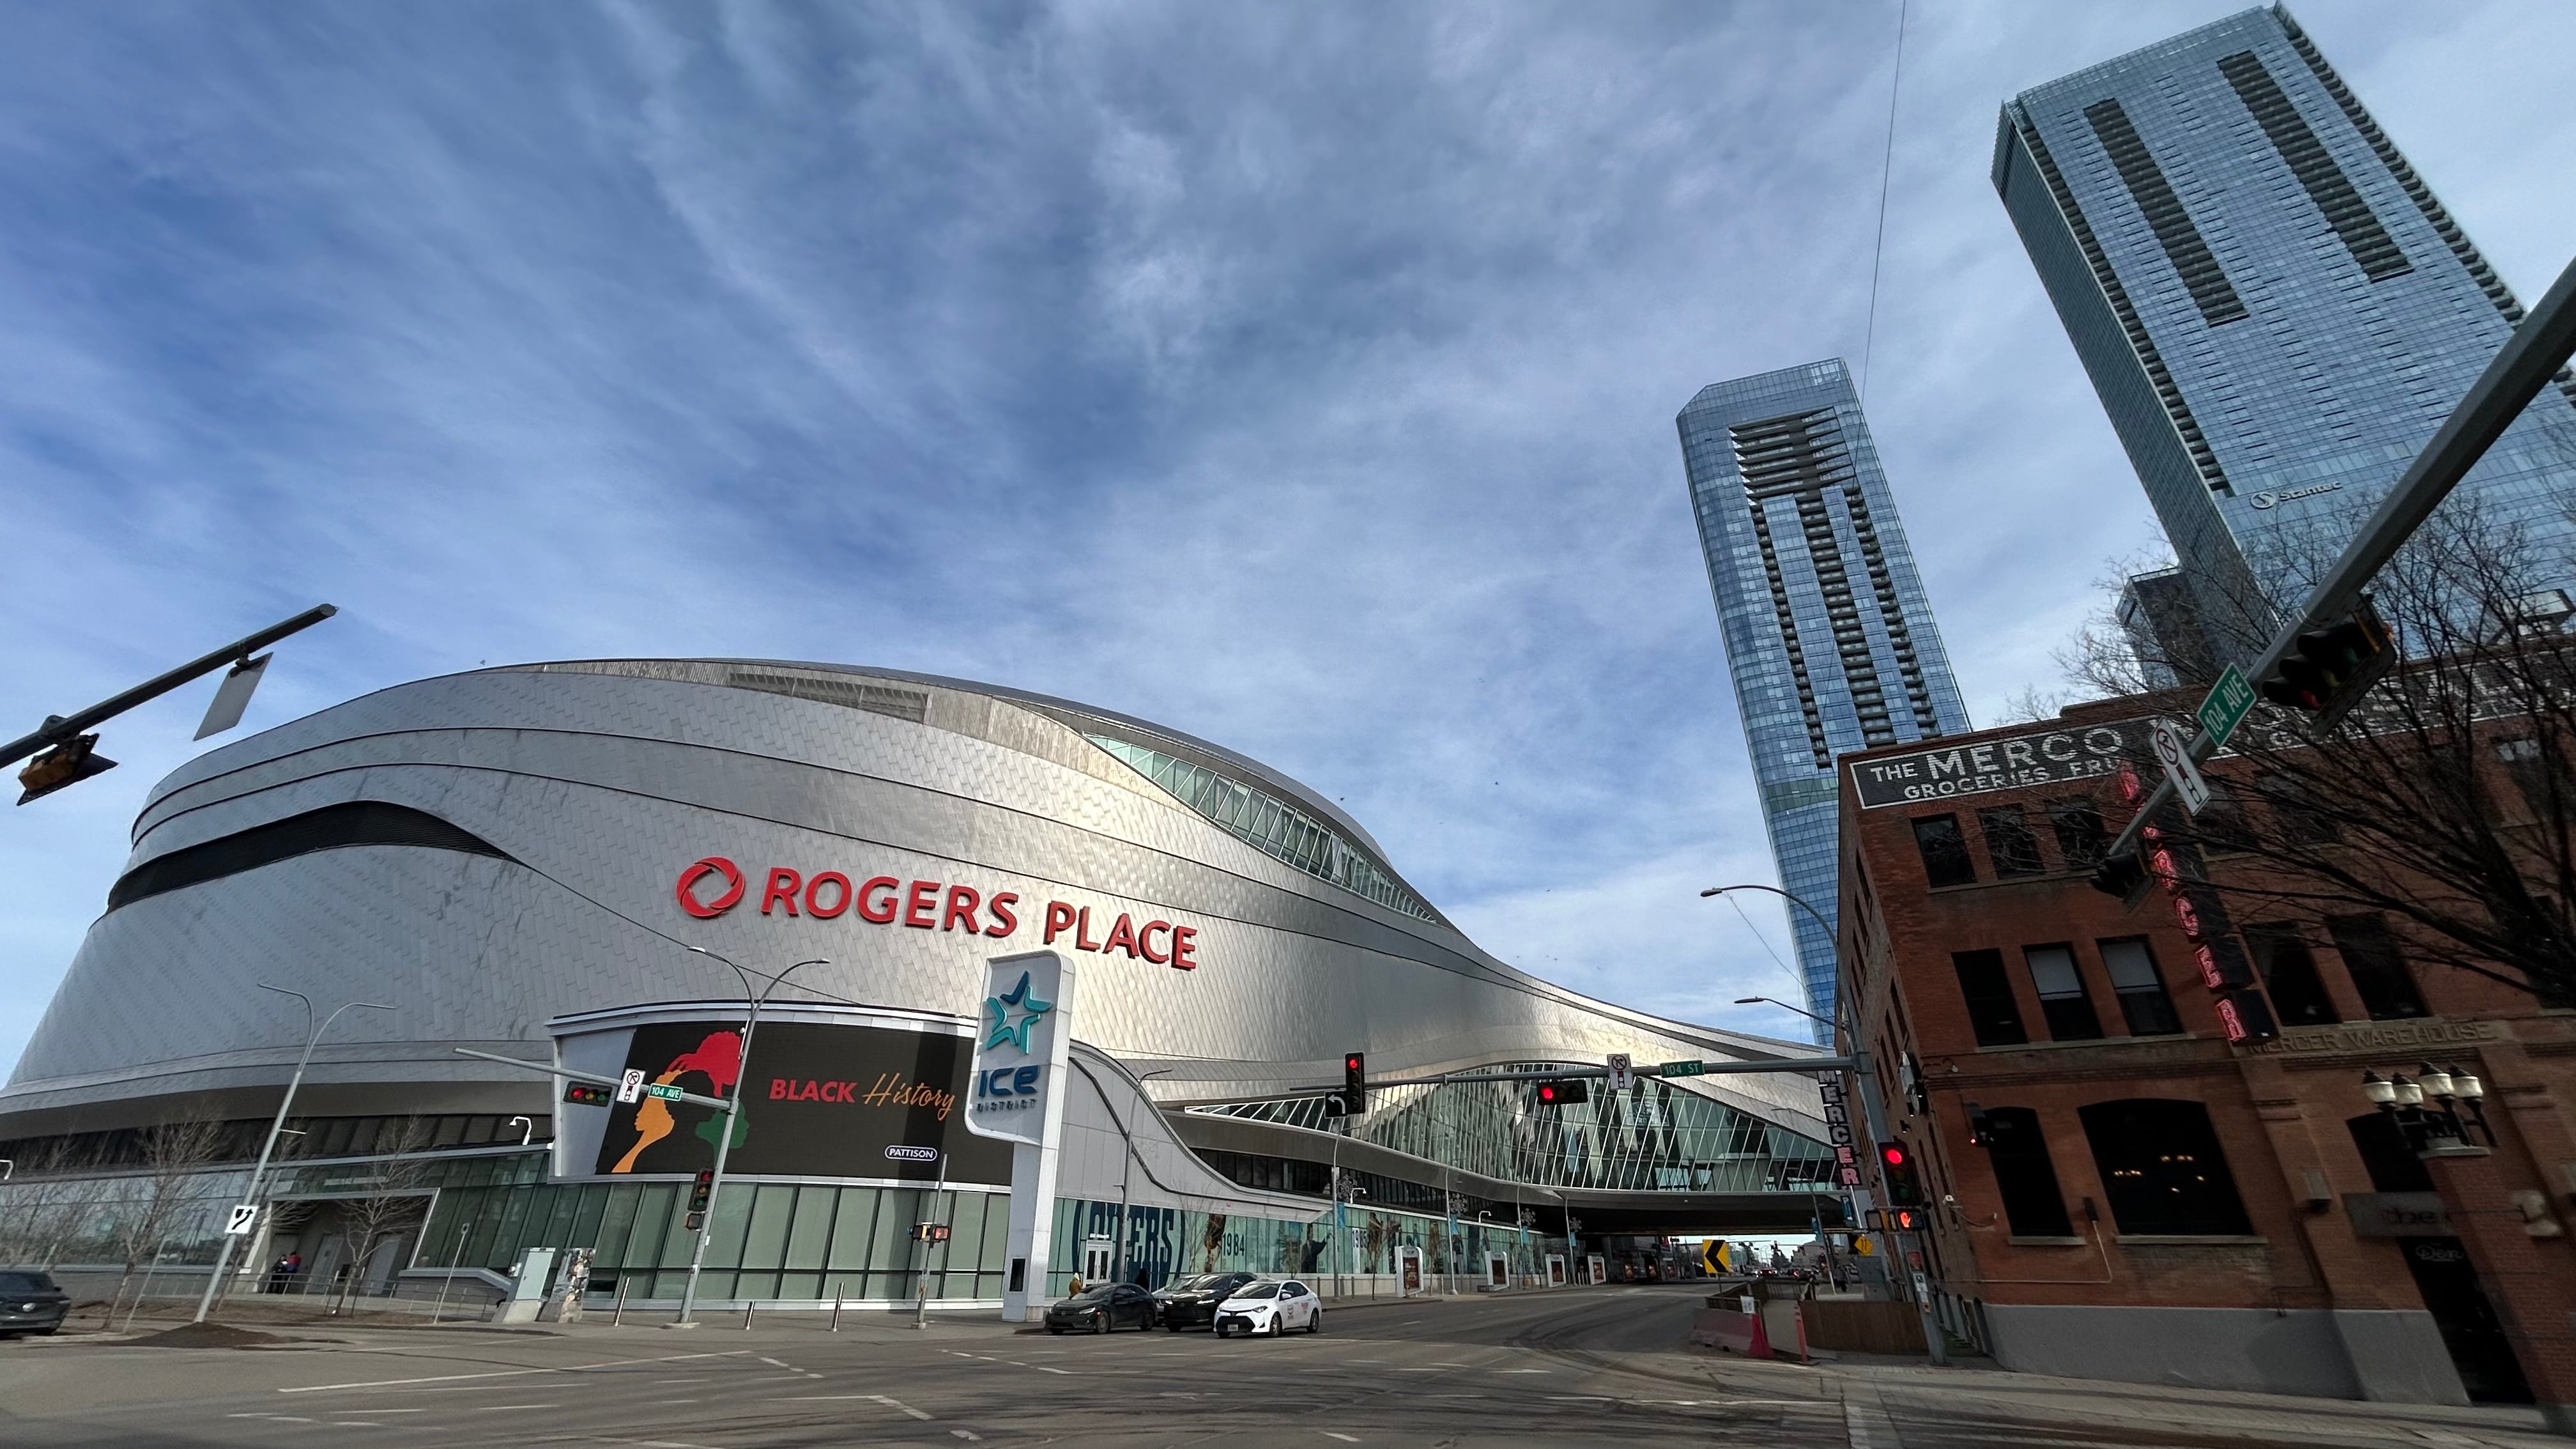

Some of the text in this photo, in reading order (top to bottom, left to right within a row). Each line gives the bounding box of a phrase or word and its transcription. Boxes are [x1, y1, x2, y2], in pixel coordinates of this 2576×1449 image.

[2280, 482, 2343, 501] Stantec
[2205, 674, 2249, 735] 104 AVE
[1870, 728, 2123, 783] THE MERCO
[1904, 767, 2051, 799] GROCERIES
[760, 866, 1198, 971] ROGERS PLACE
[2345, 1023, 2497, 1048] WAREHOUSE
[1664, 1063, 1699, 1075] 104 ST
[651, 1087, 680, 1098] 104 AVE
[769, 1072, 956, 1121] BLACK History
[1816, 1070, 1860, 1186] MERCER
[888, 1147, 934, 1158] PATTISON
[1222, 1232, 1245, 1257] 1984
